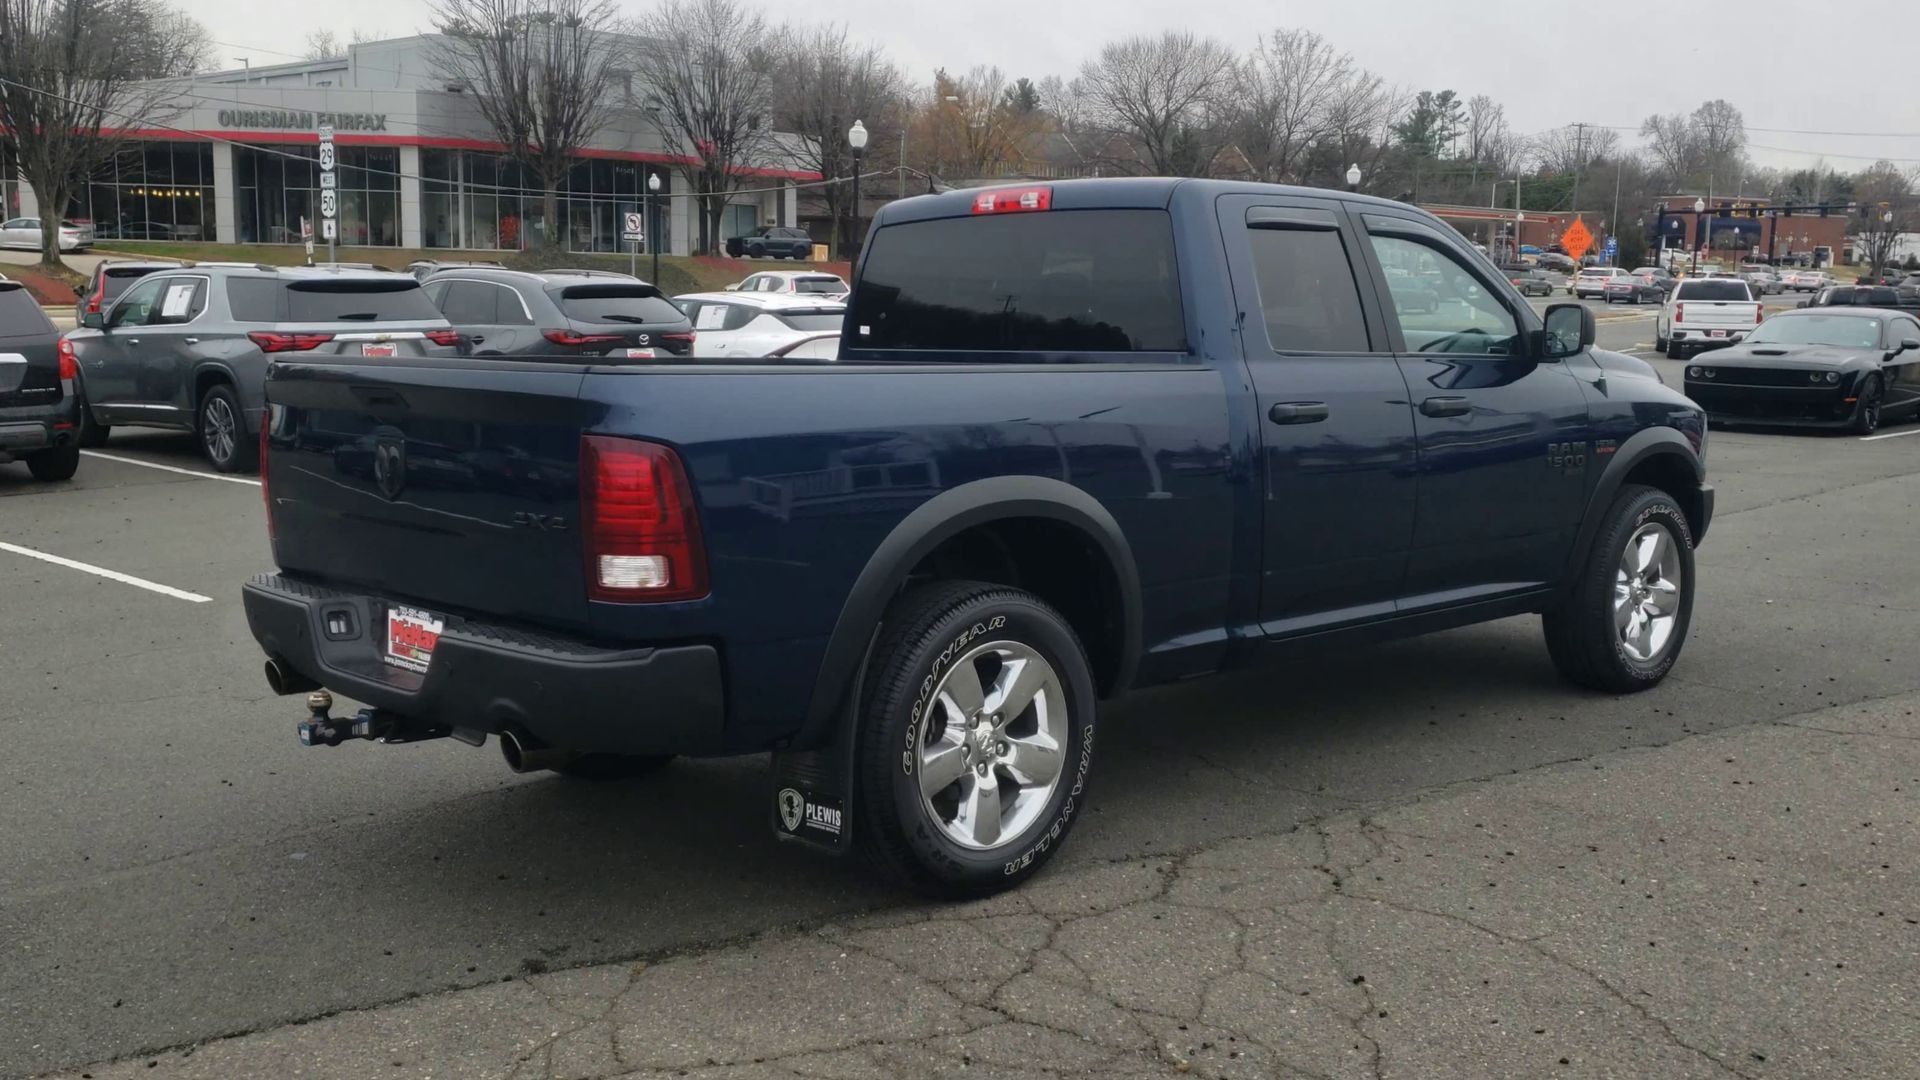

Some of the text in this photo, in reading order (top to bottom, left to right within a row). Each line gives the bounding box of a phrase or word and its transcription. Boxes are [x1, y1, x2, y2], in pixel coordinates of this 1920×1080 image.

[218, 109, 387, 131] OURISMAN FAIRFAX
[321, 148, 333, 165] 29
[322, 175, 333, 185] WEST
[323, 195, 335, 212] 50
[1547, 441, 1587, 454] RAM
[1547, 454, 1585, 467] 1500
[902, 615, 1006, 775] GOODYEAR
[1004, 723, 1094, 875] WRANGLER
[805, 802, 842, 826] PLEWIS
